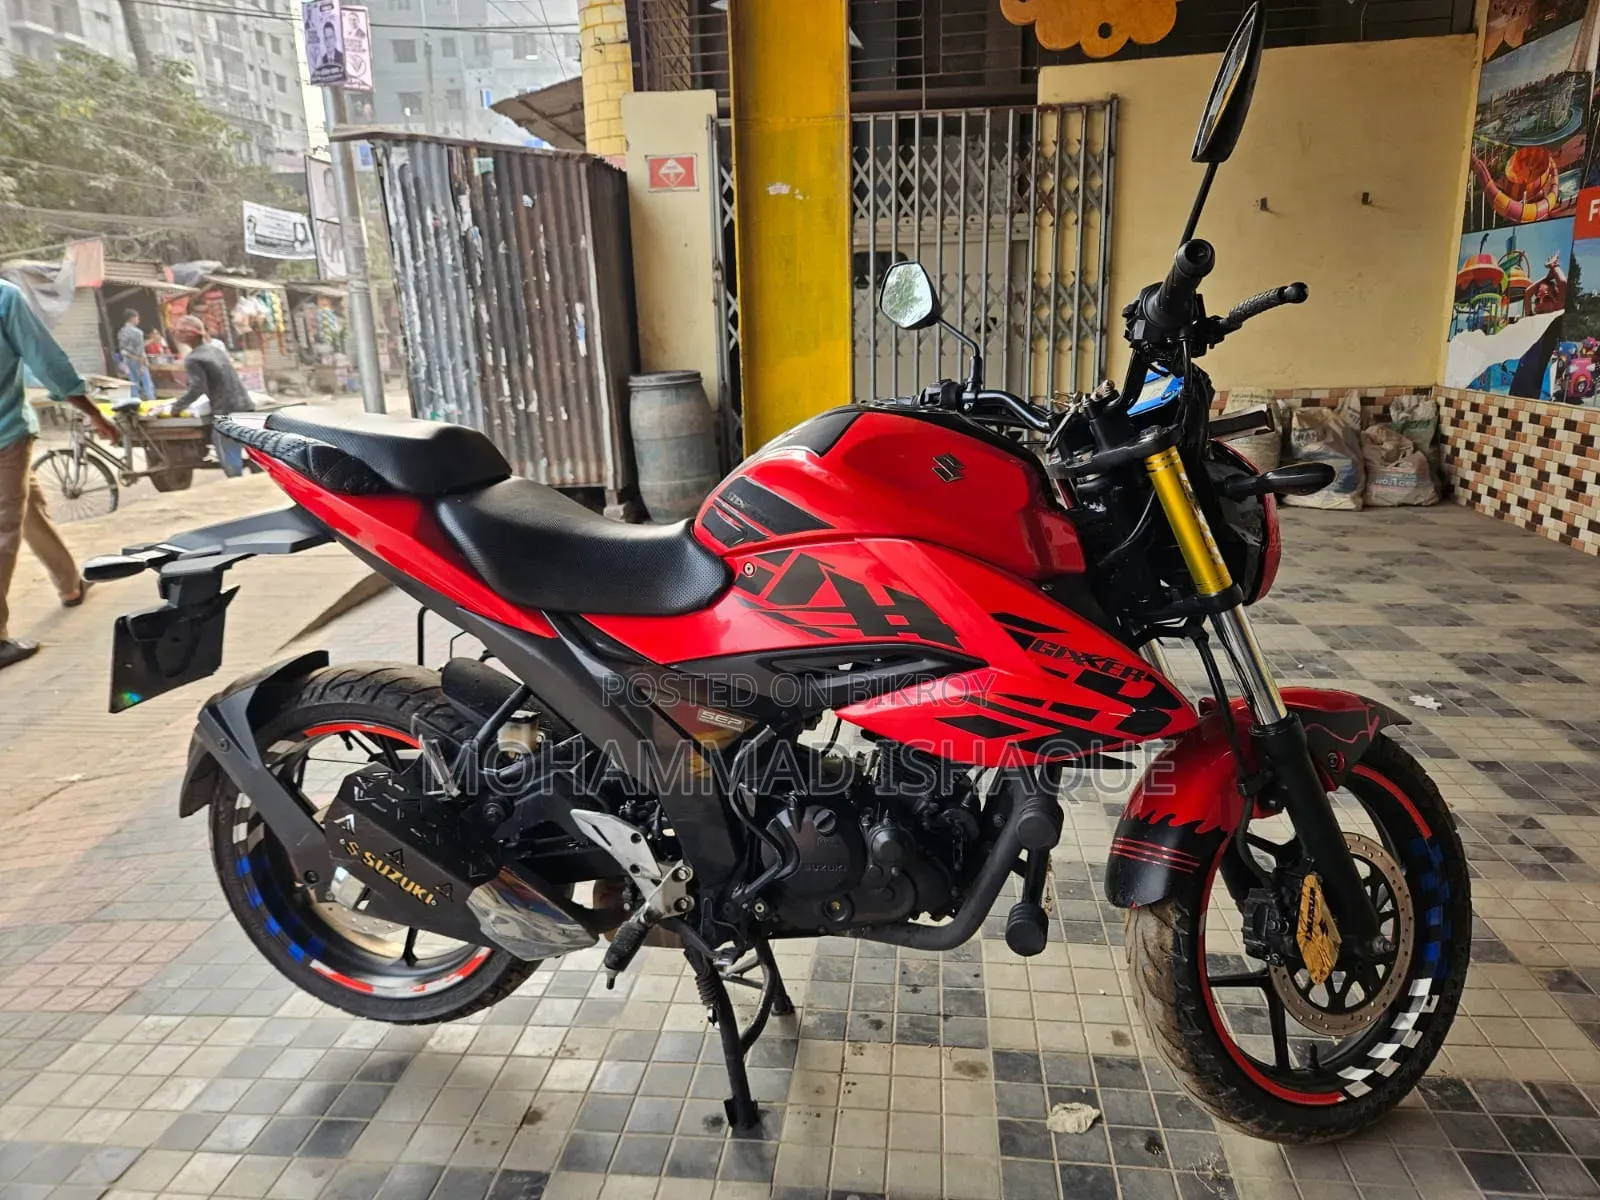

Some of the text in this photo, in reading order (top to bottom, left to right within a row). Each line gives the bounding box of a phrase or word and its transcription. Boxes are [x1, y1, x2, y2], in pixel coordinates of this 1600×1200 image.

[1588, 198, 1600, 222] F
[1030, 638, 1148, 683] GIXXER
[700, 710, 743, 726] SEP
[362, 851, 435, 905] SUZUKI
